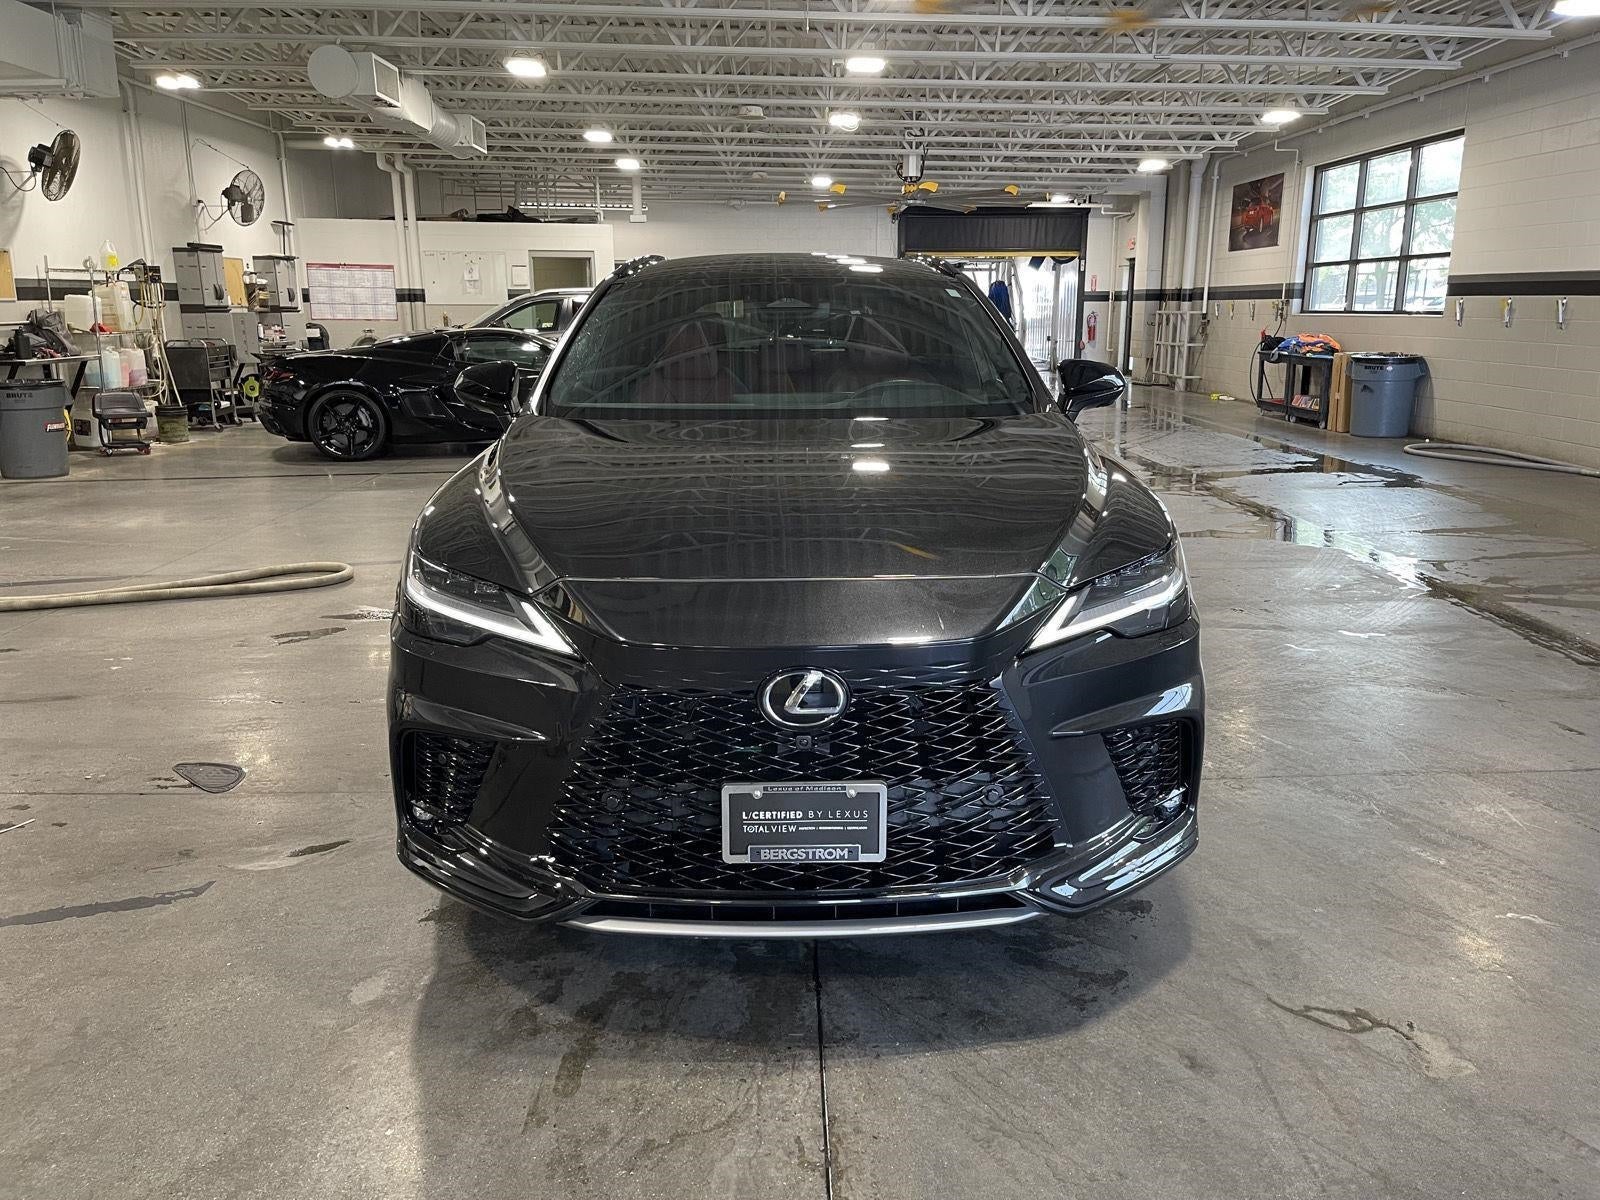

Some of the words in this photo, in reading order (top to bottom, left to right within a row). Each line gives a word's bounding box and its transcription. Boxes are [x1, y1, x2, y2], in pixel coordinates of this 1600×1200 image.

[742, 811, 803, 820] L/CERTIFIED
[808, 811, 823, 819] BY
[828, 810, 868, 819] LEXUS
[742, 825, 770, 833] TOTAL
[760, 848, 849, 860] BERGSTROM
